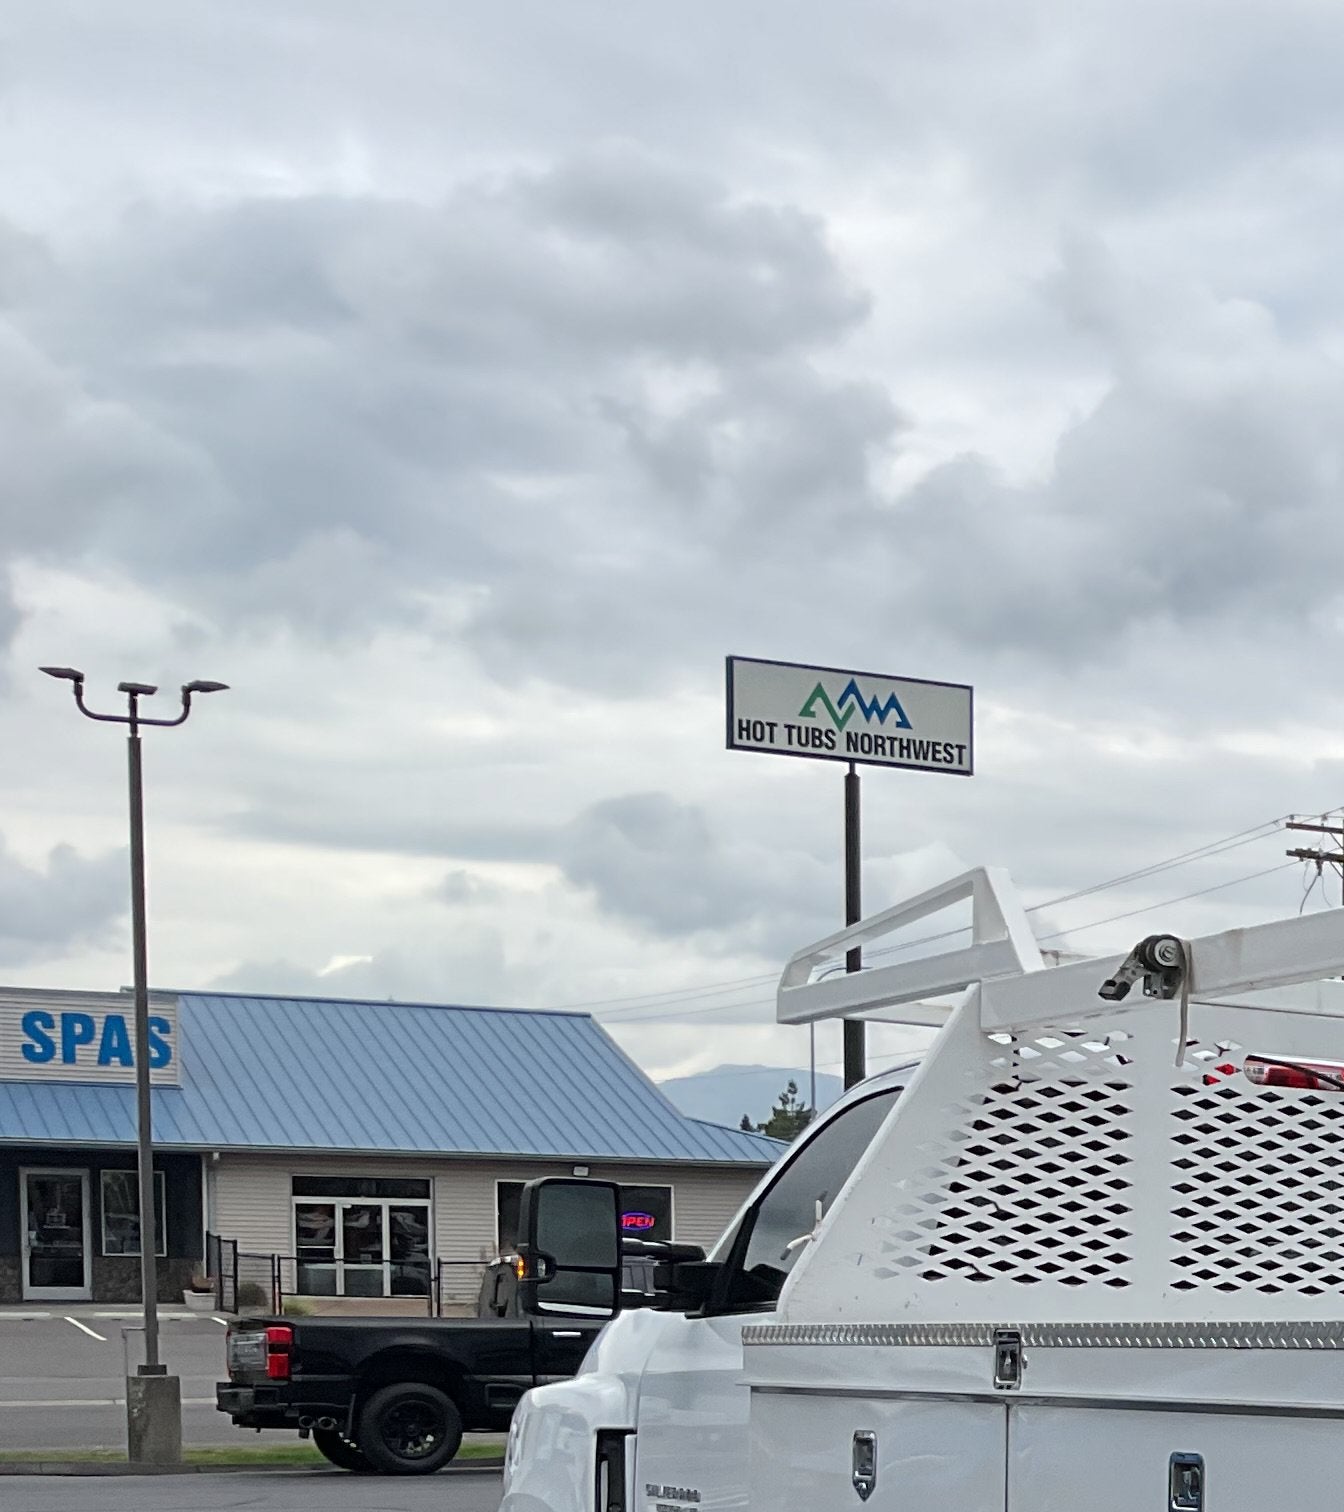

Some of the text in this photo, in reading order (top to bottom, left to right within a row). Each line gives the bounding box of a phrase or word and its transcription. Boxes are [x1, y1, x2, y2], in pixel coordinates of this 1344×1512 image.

[738, 718, 967, 766] HOT TUBS NORTHWEST
[21, 1011, 172, 1069] SPAS
[622, 1216, 655, 1227] PEN
